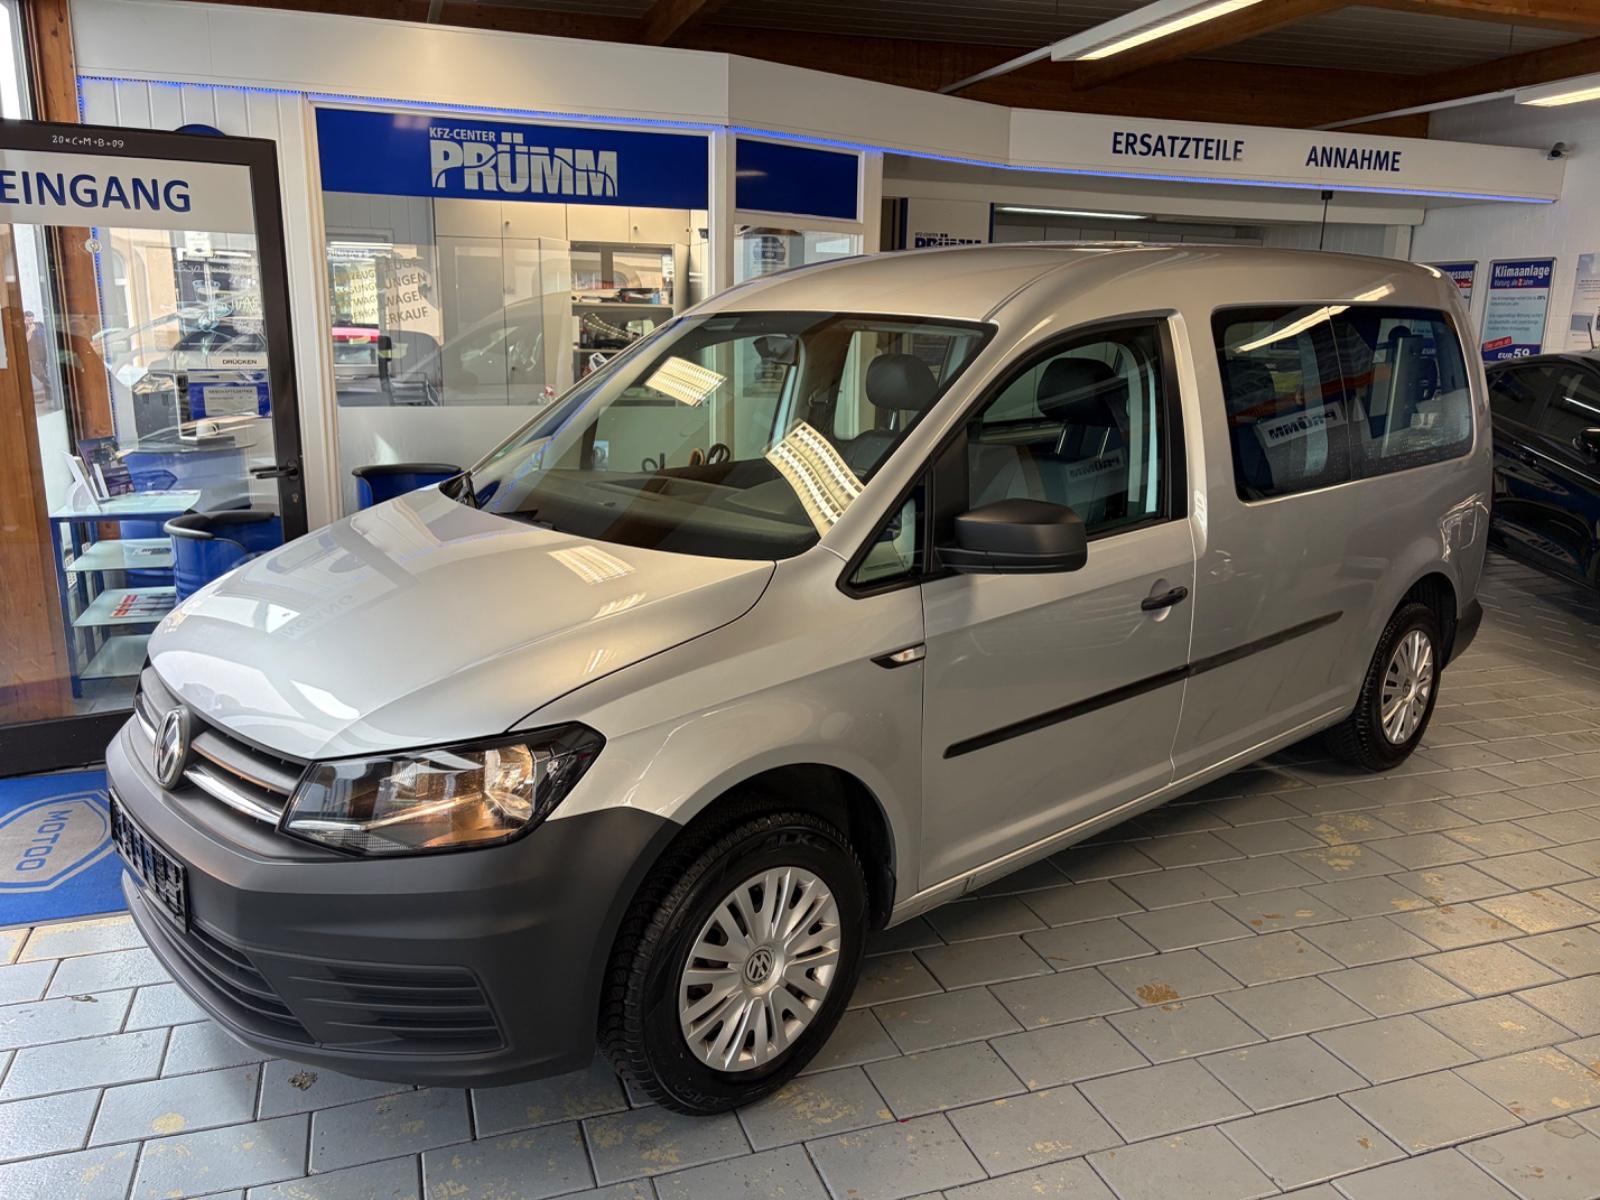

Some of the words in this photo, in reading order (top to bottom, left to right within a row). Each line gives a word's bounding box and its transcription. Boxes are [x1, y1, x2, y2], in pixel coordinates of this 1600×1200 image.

[429, 127, 496, 142] KFZ-CENTER
[1112, 131, 1244, 162] ERSATZTEILE
[429, 131, 618, 198] PRÜMM
[1305, 145, 1402, 172] ANNAHME
[0, 169, 192, 213] EINGANG
[1494, 263, 1551, 280] Klimaanlage
[1497, 352, 1513, 360] EUR
[1513, 348, 1531, 358] 59
[14, 808, 74, 872] MOTOO
